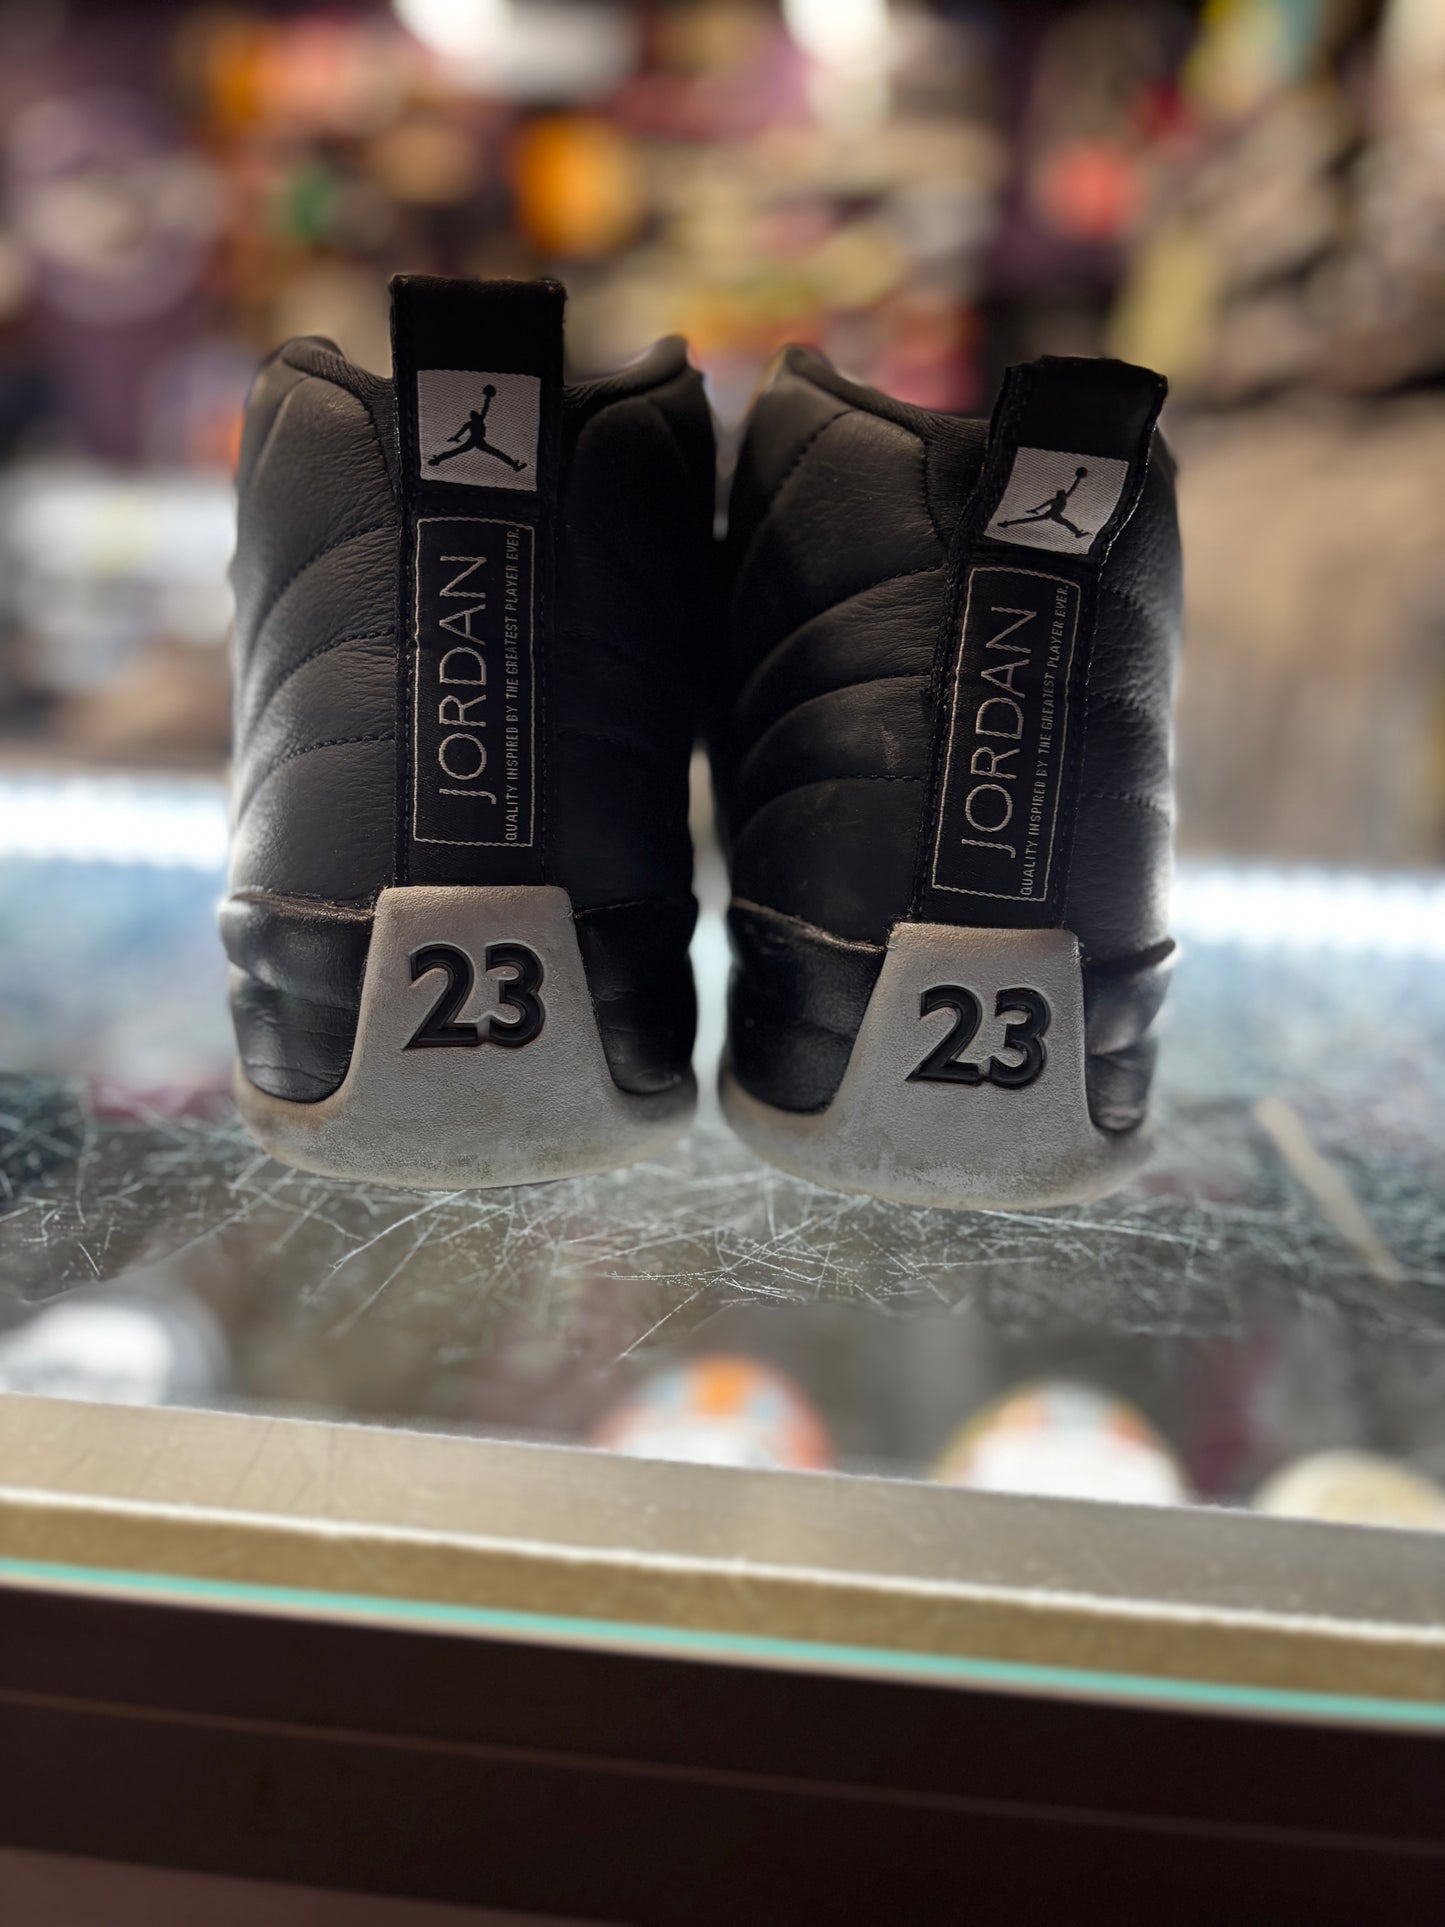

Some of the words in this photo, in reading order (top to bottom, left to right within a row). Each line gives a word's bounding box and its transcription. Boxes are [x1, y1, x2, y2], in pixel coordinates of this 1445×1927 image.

[505, 566, 519, 611] PLAYER
[504, 617, 519, 675] GREATEST
[1047, 620, 1065, 668] PLAYER
[438, 555, 497, 805] JORDAN
[505, 677, 519, 699] THE
[1041, 672, 1056, 731] GREATEST
[505, 705, 519, 722] BY
[961, 606, 1037, 859] JORDAN
[505, 727, 519, 780] INSPIRED
[1035, 760, 1049, 777] BY
[1038, 733, 1052, 755] THE
[505, 785, 519, 841] QUALITY
[1028, 781, 1046, 836] INSPIRED
[1020, 840, 1038, 896] QUALITY
[402, 941, 546, 1050] 23
[905, 983, 1051, 1090] 23
